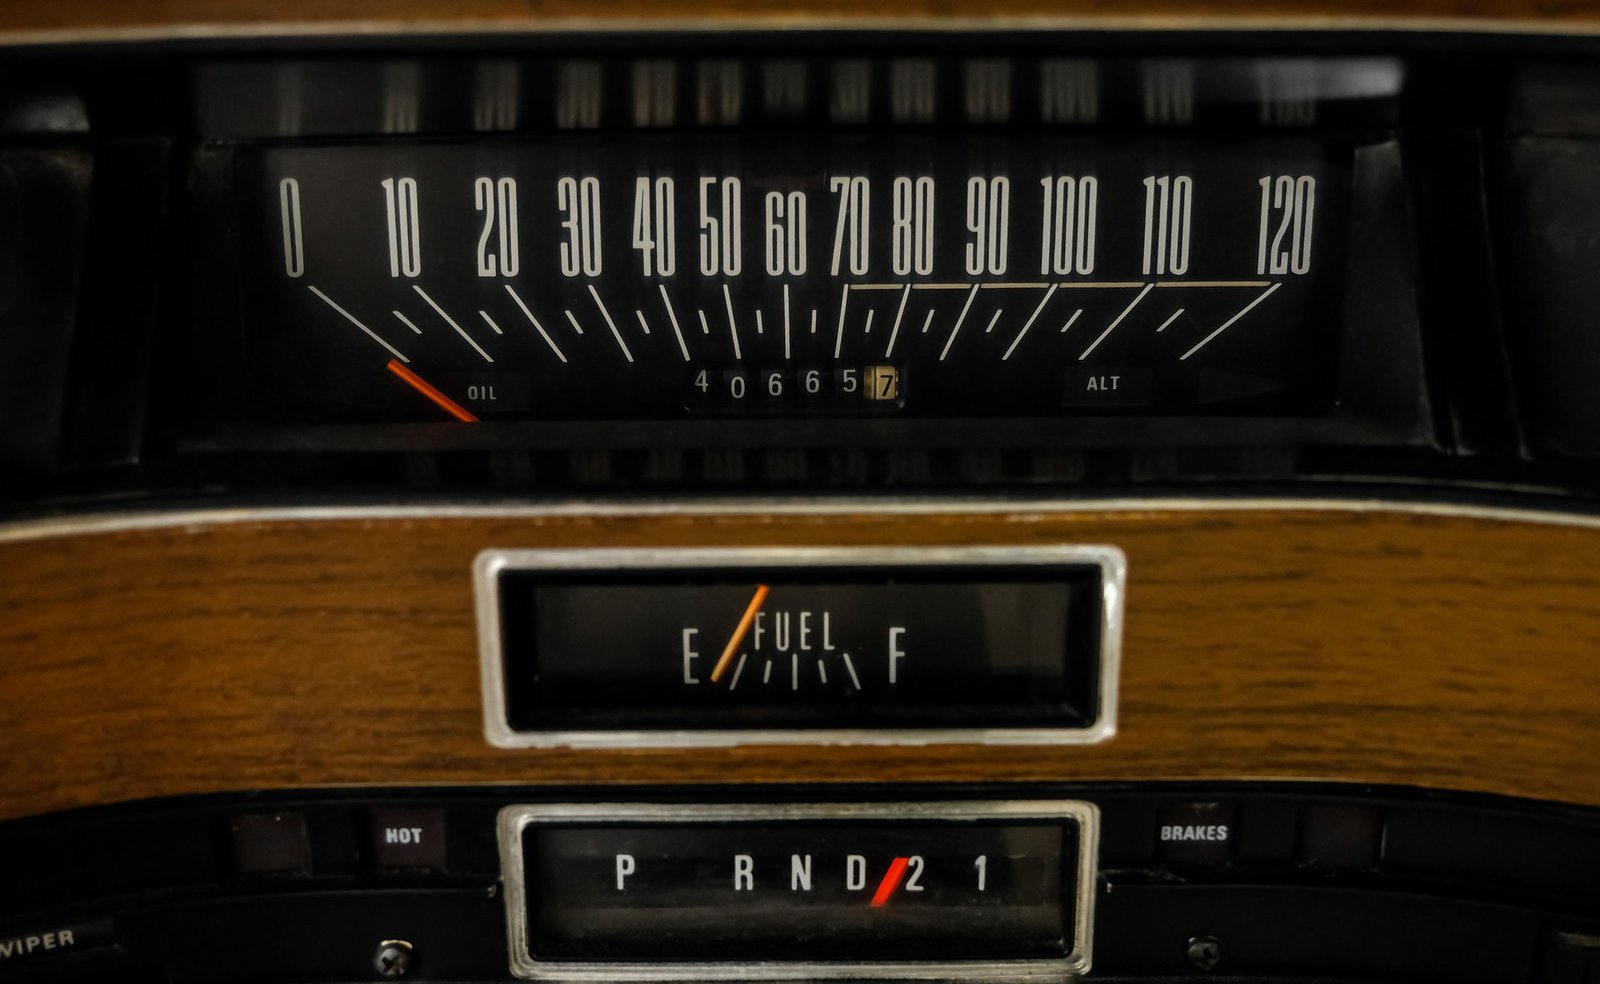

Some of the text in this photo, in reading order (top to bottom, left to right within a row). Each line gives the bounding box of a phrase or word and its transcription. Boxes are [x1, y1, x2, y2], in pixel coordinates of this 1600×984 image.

[280, 175, 1316, 278] 0 10 20 30 40 50 60 70 80 90 100 110 120
[466, 385, 497, 400] OIL
[1086, 376, 1120, 391] ALT
[754, 611, 835, 651] FUEL
[682, 626, 906, 684] E F
[385, 827, 423, 844] HOT
[1161, 825, 1228, 841] BRAKES
[616, 854, 987, 892] P R N D 2 1
